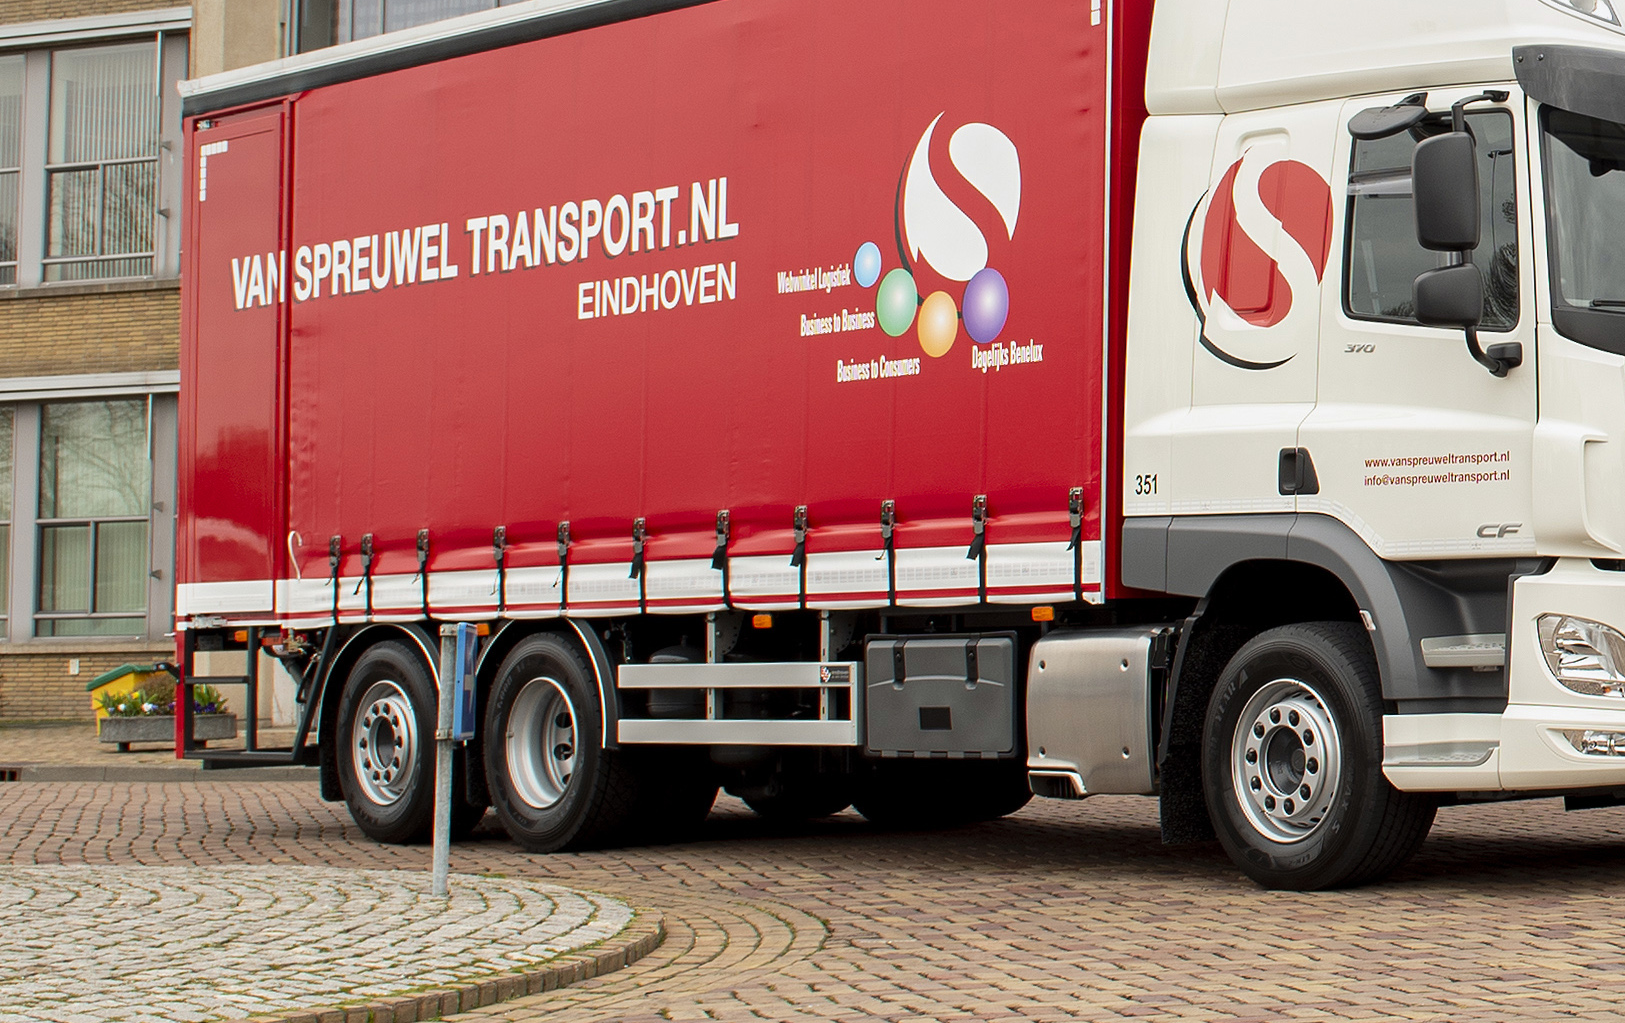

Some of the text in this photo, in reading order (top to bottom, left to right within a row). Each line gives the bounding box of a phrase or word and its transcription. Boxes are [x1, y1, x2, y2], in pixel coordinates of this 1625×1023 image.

[231, 176, 739, 310] VAN SPREUWEL TRANSPORT.NL
[577, 260, 737, 320] EINDHOVEN
[777, 263, 851, 294] Webwinkel Logistiek
[800, 308, 876, 337] Business to Business
[972, 338, 1044, 374] Dagelijks Benelux
[1343, 343, 1376, 353] 370
[837, 354, 921, 383] Business to Consumers
[1364, 450, 1510, 468] www.vanspreuweltransport.nl
[1134, 474, 1158, 496] 351
[1364, 469, 1510, 487] info@vanspreuweltransport.nl
[1475, 522, 1523, 538] CF
